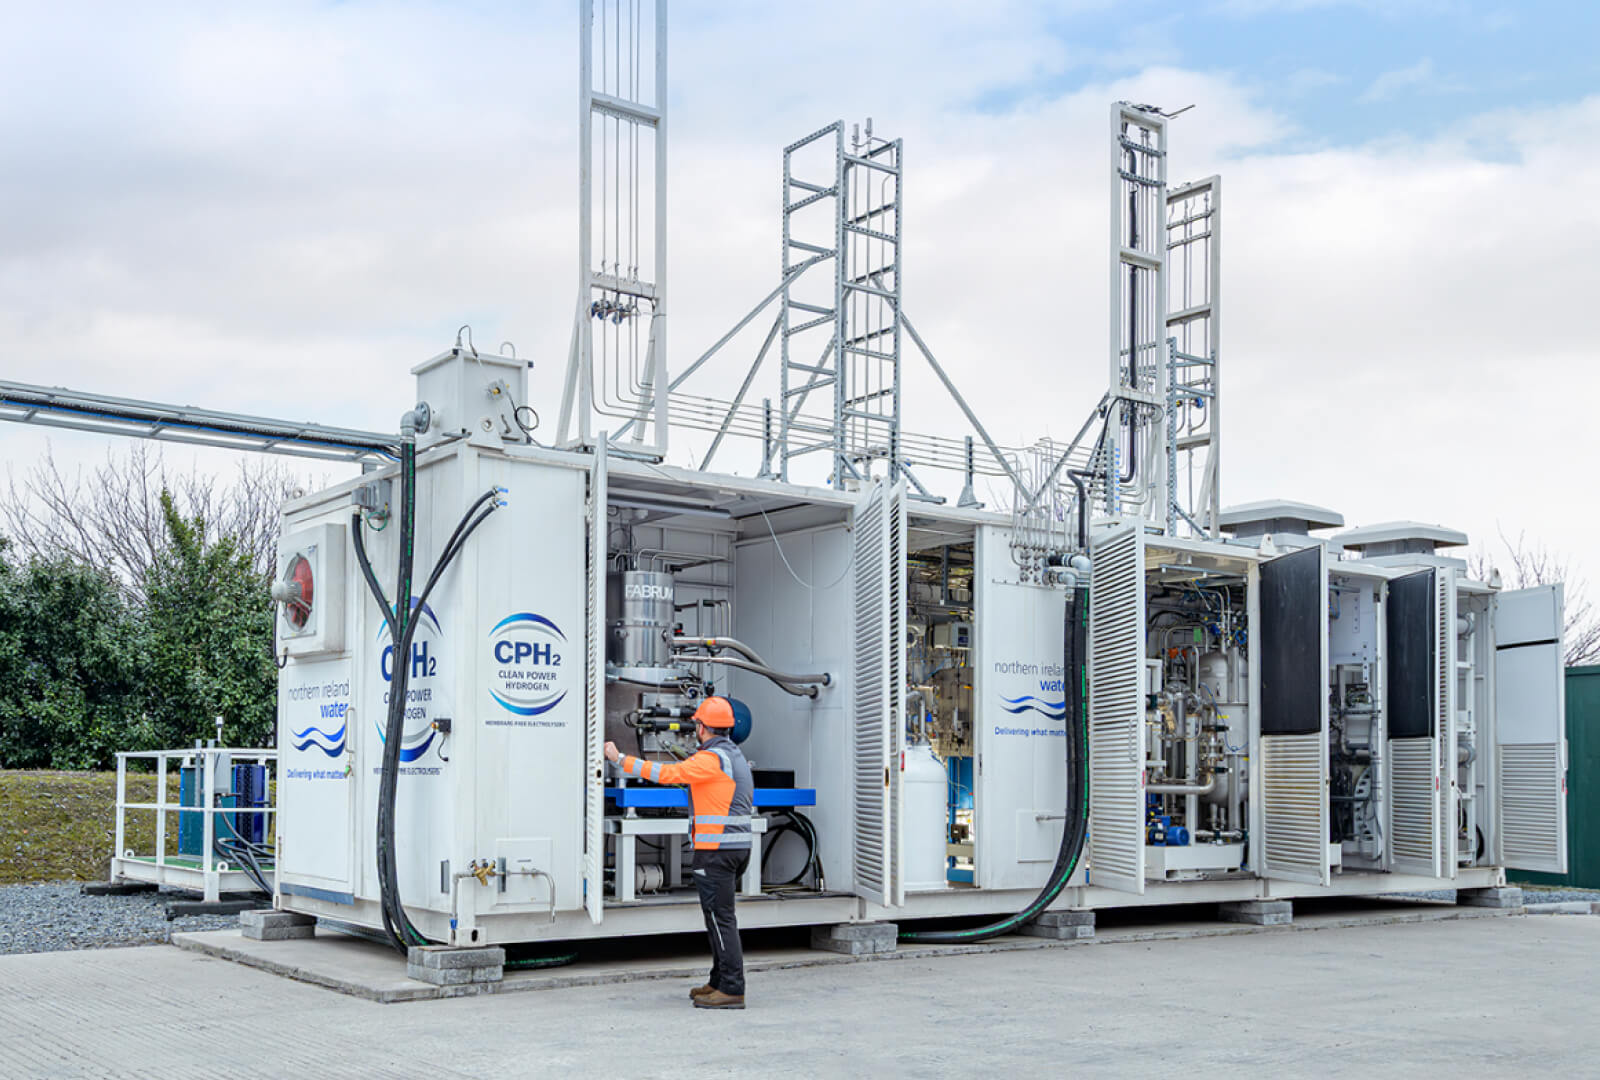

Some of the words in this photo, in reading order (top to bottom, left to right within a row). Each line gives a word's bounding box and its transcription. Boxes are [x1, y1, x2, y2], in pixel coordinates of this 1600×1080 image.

[381, 641, 437, 682] CH2
[995, 660, 1038, 675] northern
[1041, 662, 1065, 677] irela
[498, 670, 524, 679] CLEAN
[526, 671, 557, 680] POWER
[288, 683, 320, 700] northern
[322, 678, 350, 699] ireland
[505, 681, 550, 690] HYDROGEN
[994, 726, 1029, 736] Delivering
[1031, 727, 1048, 736] what
[287, 769, 312, 780] Delivering
[313, 769, 326, 779] what
